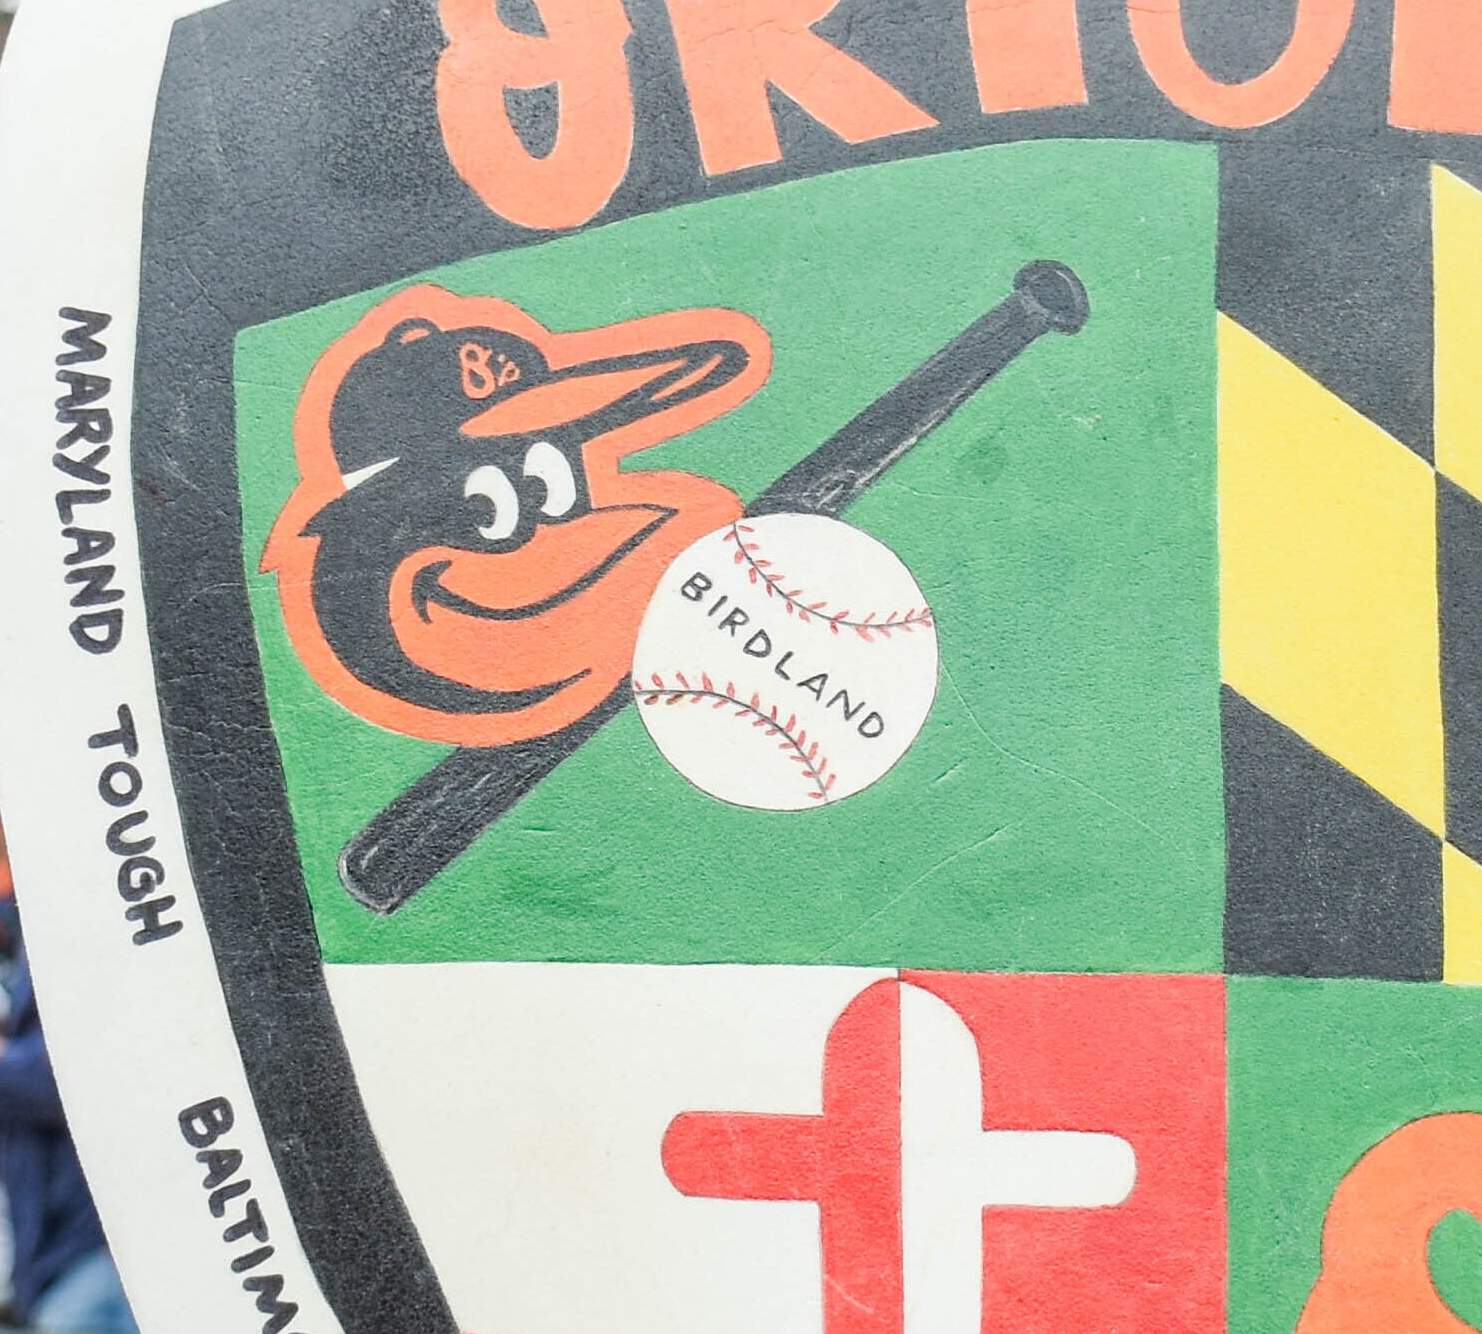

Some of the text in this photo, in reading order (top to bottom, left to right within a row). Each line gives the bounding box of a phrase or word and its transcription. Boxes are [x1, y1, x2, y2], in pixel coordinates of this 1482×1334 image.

[53, 307, 125, 656] MARYLAND
[680, 571, 885, 739] BIRDLAND
[88, 703, 184, 946] TOUGH
